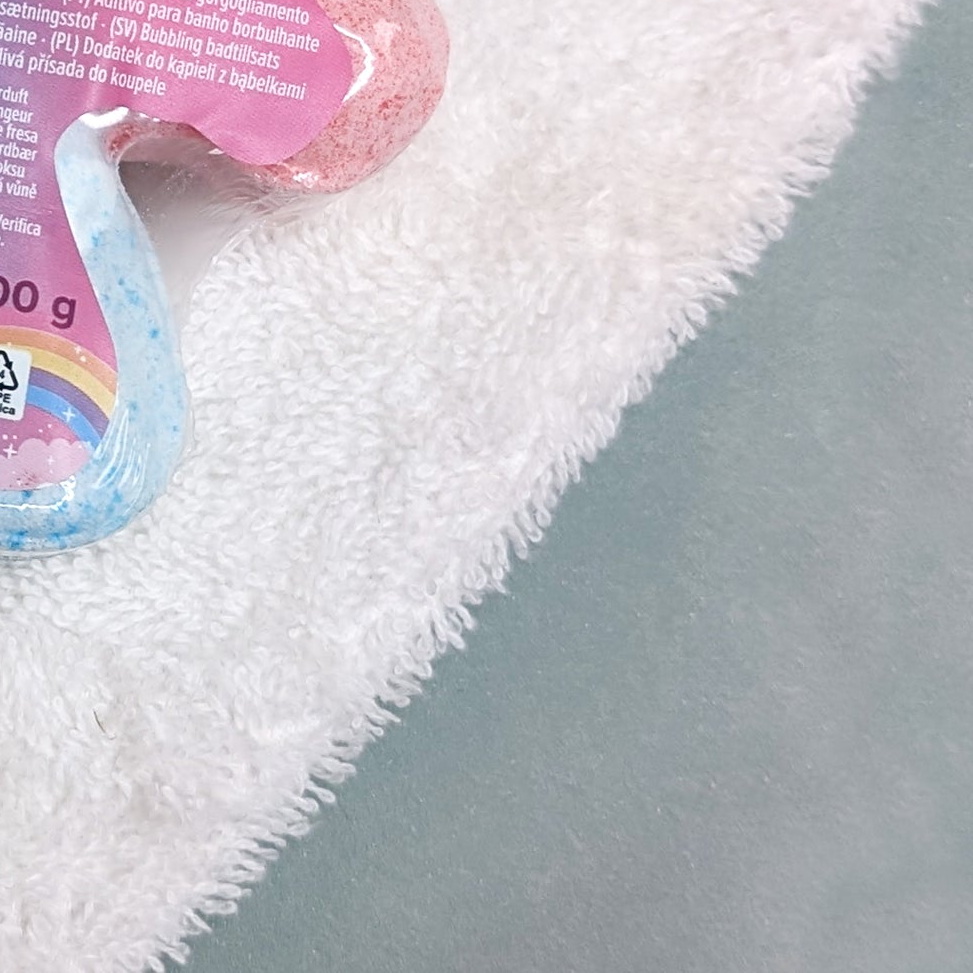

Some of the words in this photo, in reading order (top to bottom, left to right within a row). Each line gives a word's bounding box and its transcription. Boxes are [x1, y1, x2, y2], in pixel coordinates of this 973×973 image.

[110, 16, 137, 42] (SV)
[140, 22, 202, 56] Bubbling
[206, 38, 280, 69] badtillsats
[148, 2, 180, 22] para
[185, 7, 228, 33] banho
[232, 20, 319, 52] borbulhante
[28, 54, 85, 77] přísada
[89, 62, 107, 82] do
[111, 67, 166, 96] koupele
[51, 31, 79, 56] (PL)
[83, 36, 143, 66] Dodatek
[146, 50, 164, 69] do
[168, 54, 216, 79] kąpieli
[219, 70, 226, 83] z
[229, 68, 306, 100] bąbelkami
[6, 125, 38, 143] fresa
[6, 179, 37, 199] vůně
[51, 296, 77, 329] g
